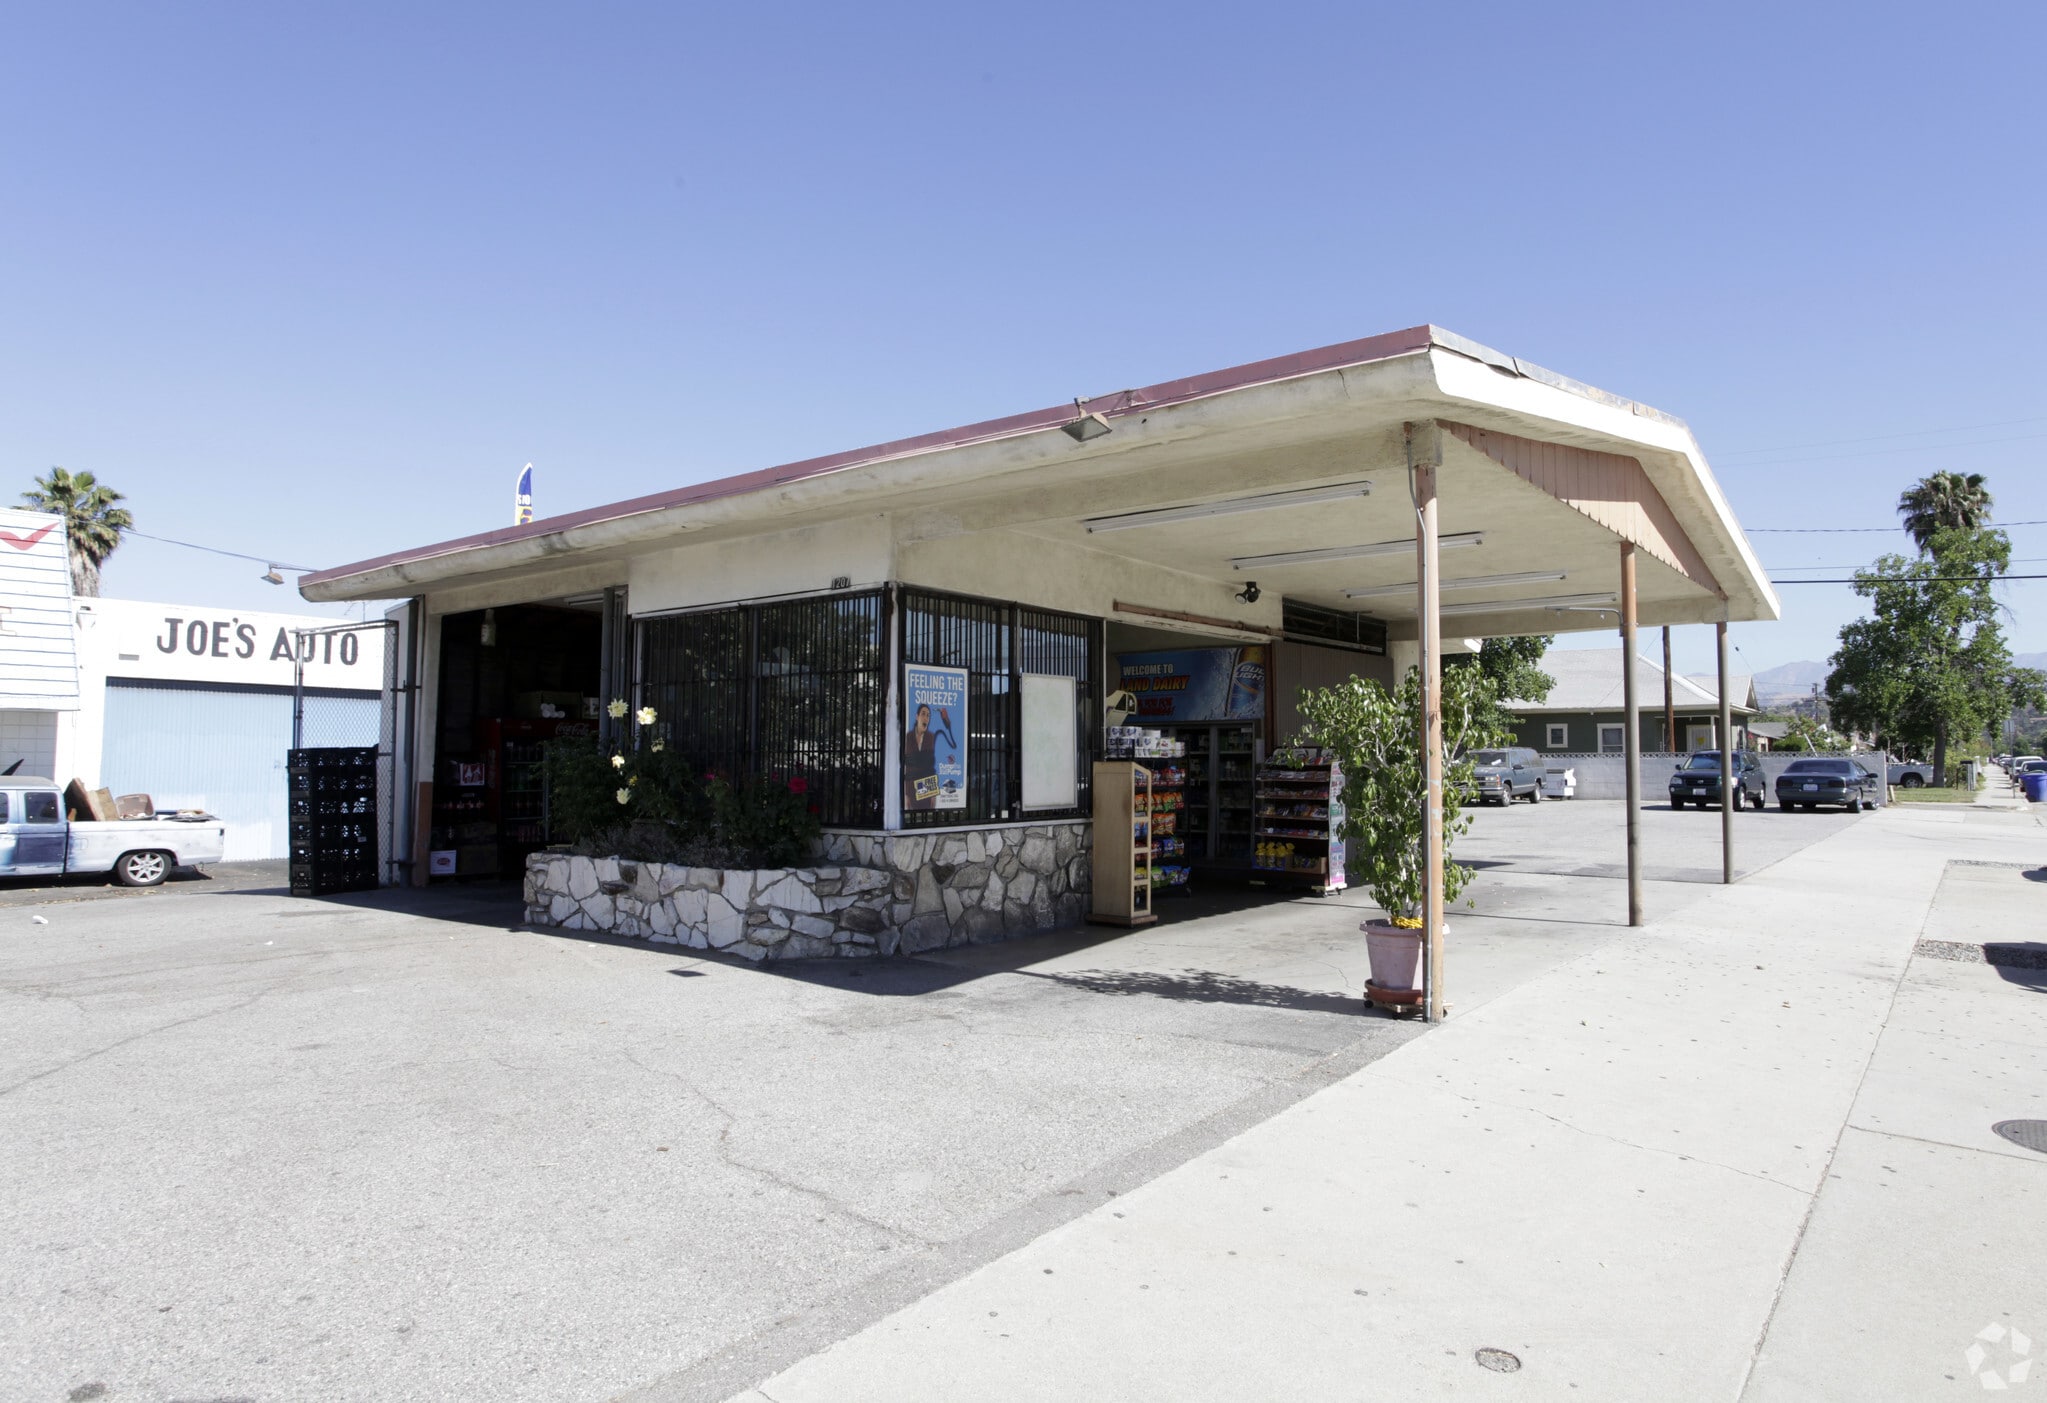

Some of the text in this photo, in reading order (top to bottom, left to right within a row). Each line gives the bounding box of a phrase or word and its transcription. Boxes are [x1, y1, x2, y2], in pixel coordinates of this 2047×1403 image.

[832, 577, 850, 590] 1207
[157, 617, 358, 666] JOE'S AUTO
[1123, 663, 1174, 676] WELCOME TO
[909, 673, 963, 691] FEELING THE
[1152, 675, 1190, 691] DAIRY
[915, 690, 958, 706] SQUEEZE?
